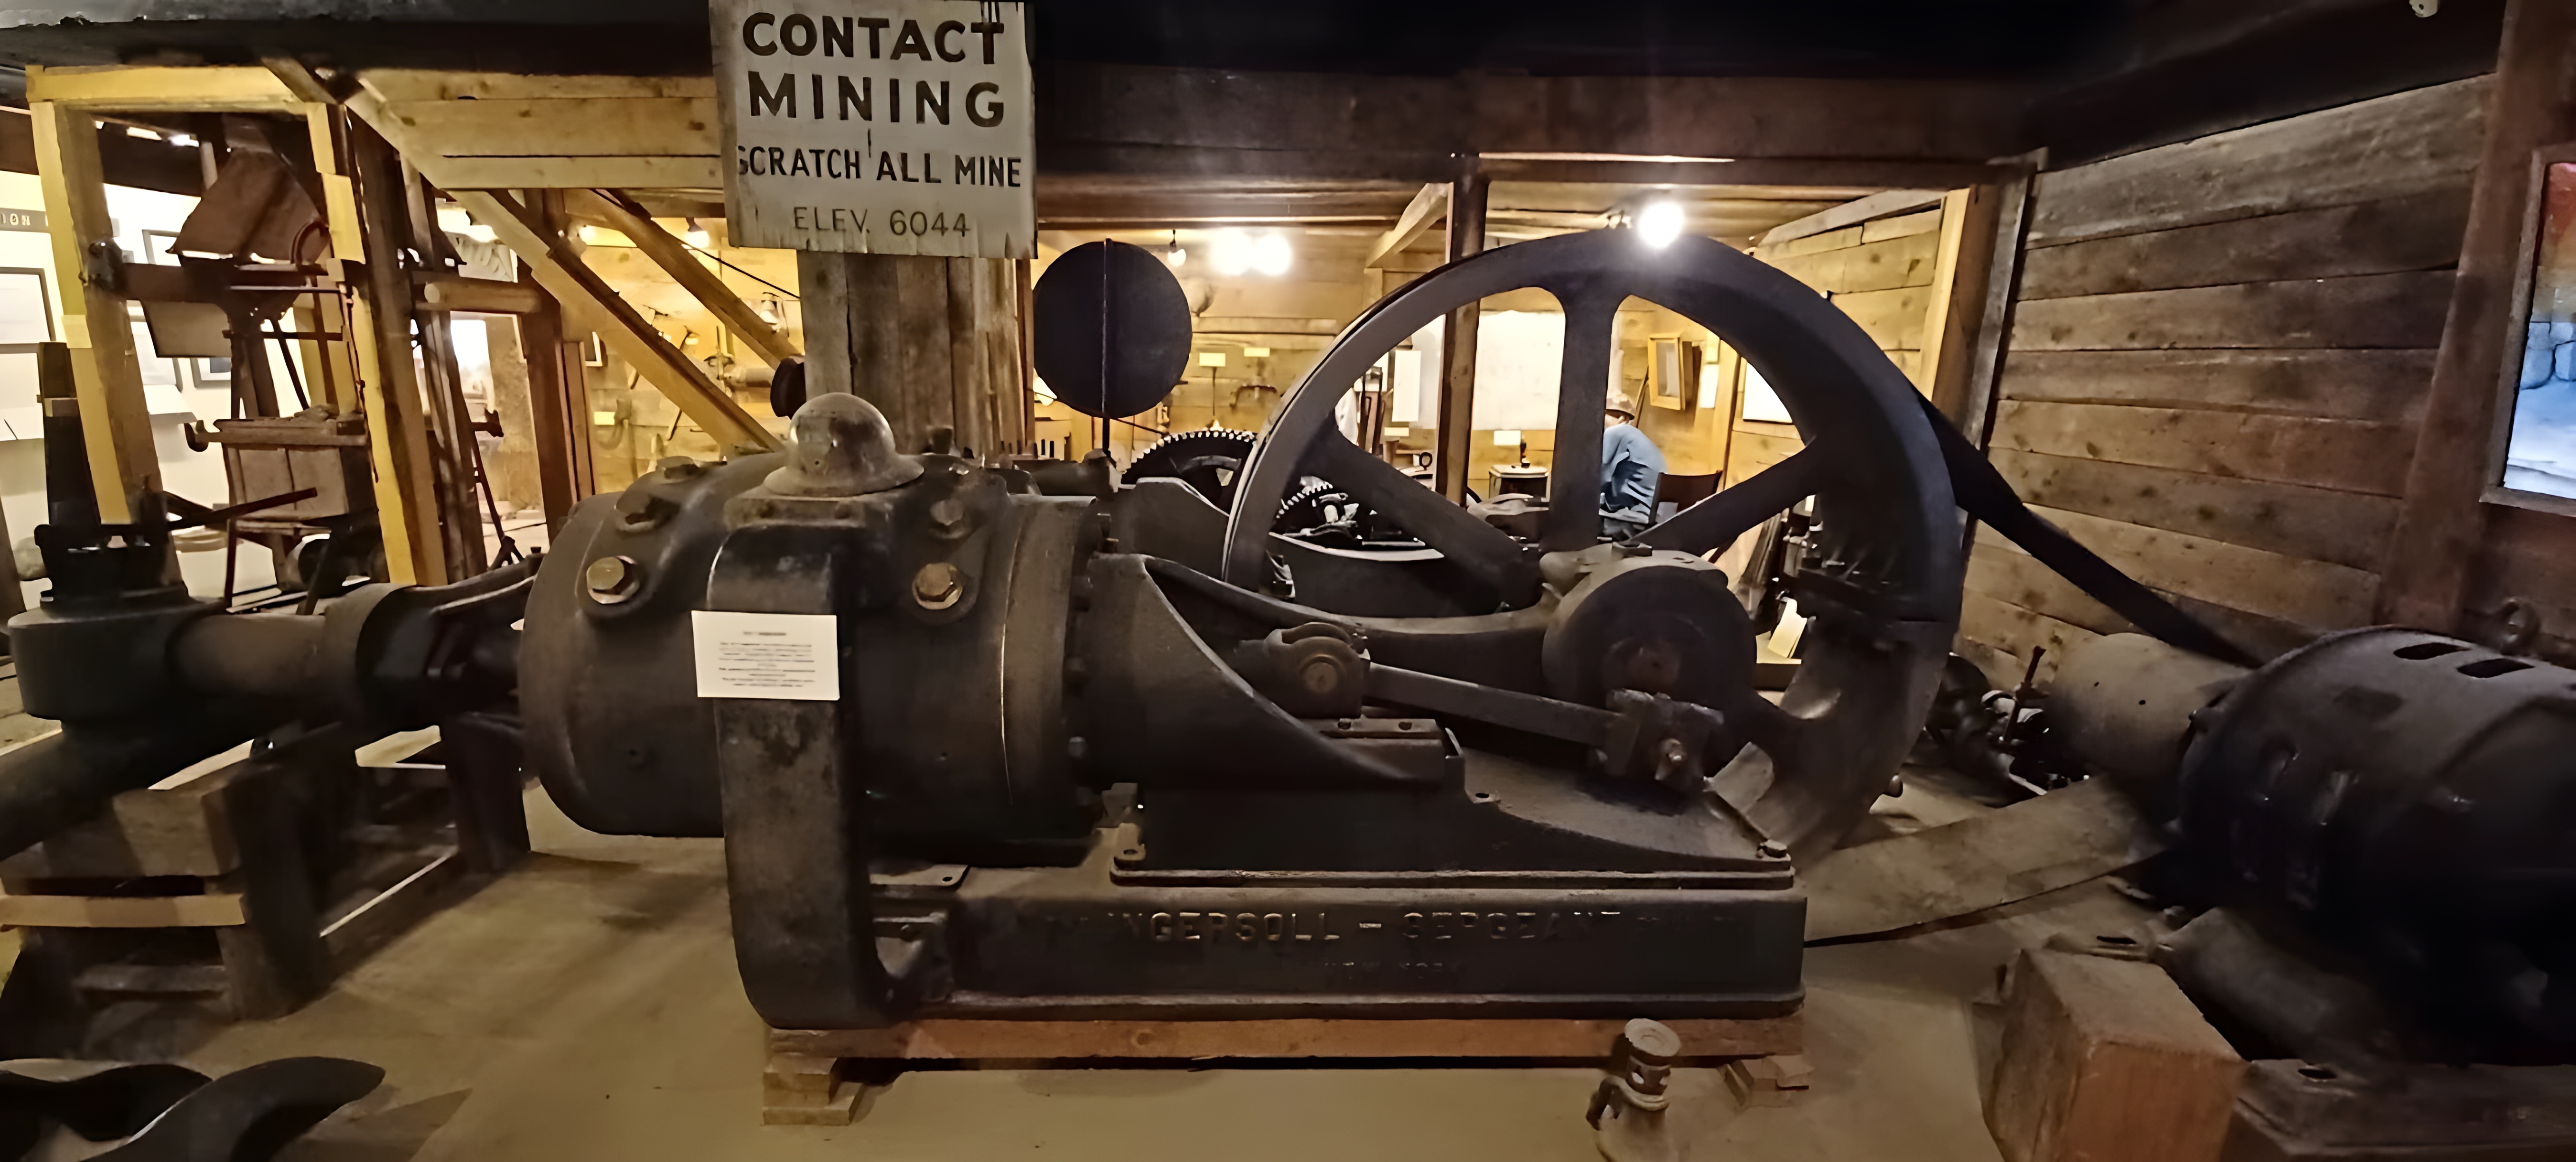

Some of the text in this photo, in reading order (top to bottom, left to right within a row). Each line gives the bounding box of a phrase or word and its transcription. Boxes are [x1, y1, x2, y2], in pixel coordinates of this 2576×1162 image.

[743, 12, 1004, 65] CONTACT
[748, 71, 1004, 128] MINING
[877, 151, 942, 183] ALL
[955, 154, 1021, 187] MINE
[793, 206, 970, 237] ELEV. 6044
[1107, 912, 1341, 940] NGERSOLL
